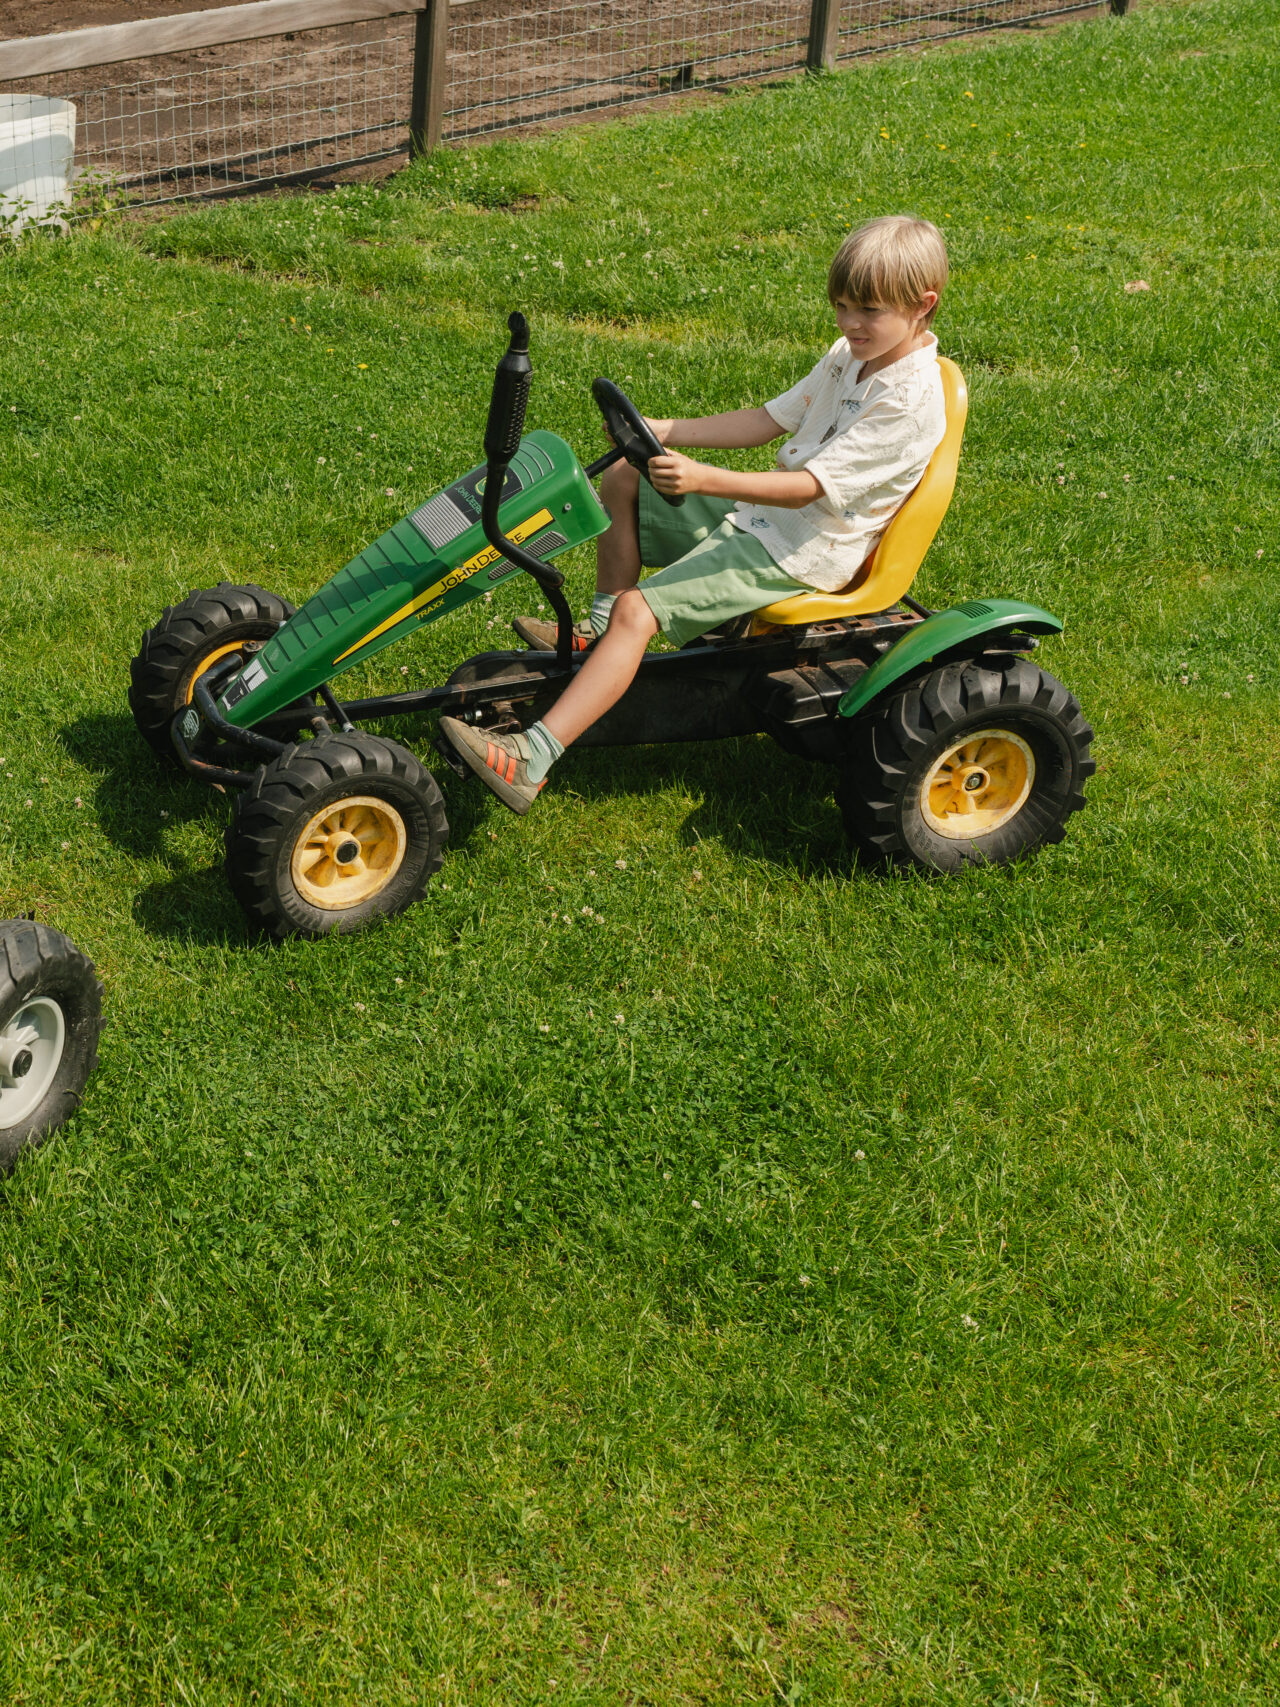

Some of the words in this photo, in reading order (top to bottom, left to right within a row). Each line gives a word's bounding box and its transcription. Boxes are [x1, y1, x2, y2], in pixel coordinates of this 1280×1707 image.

[440, 563, 477, 593] JOHN
[476, 532, 525, 567] DEE
[415, 598, 445, 620] TRAXX
